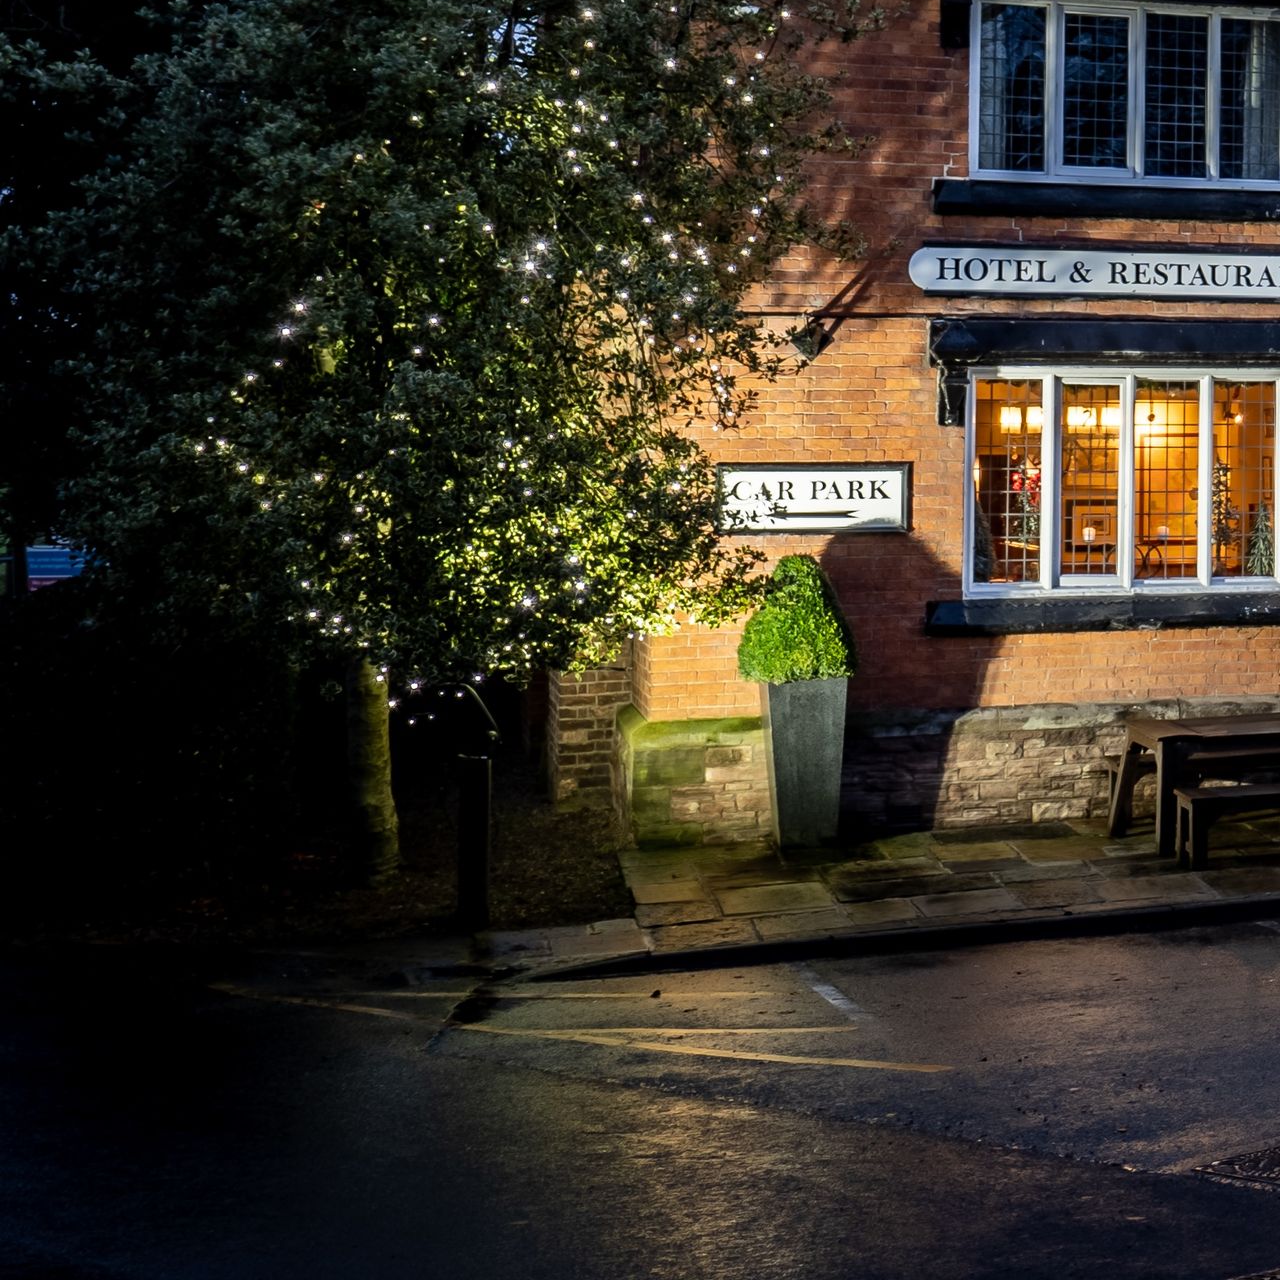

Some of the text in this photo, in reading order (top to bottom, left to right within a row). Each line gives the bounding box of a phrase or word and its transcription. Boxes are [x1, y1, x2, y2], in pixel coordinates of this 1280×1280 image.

[936, 257, 1056, 283] HOTEL
[1069, 261, 1093, 283] &
[733, 480, 892, 501] CAR PARK
